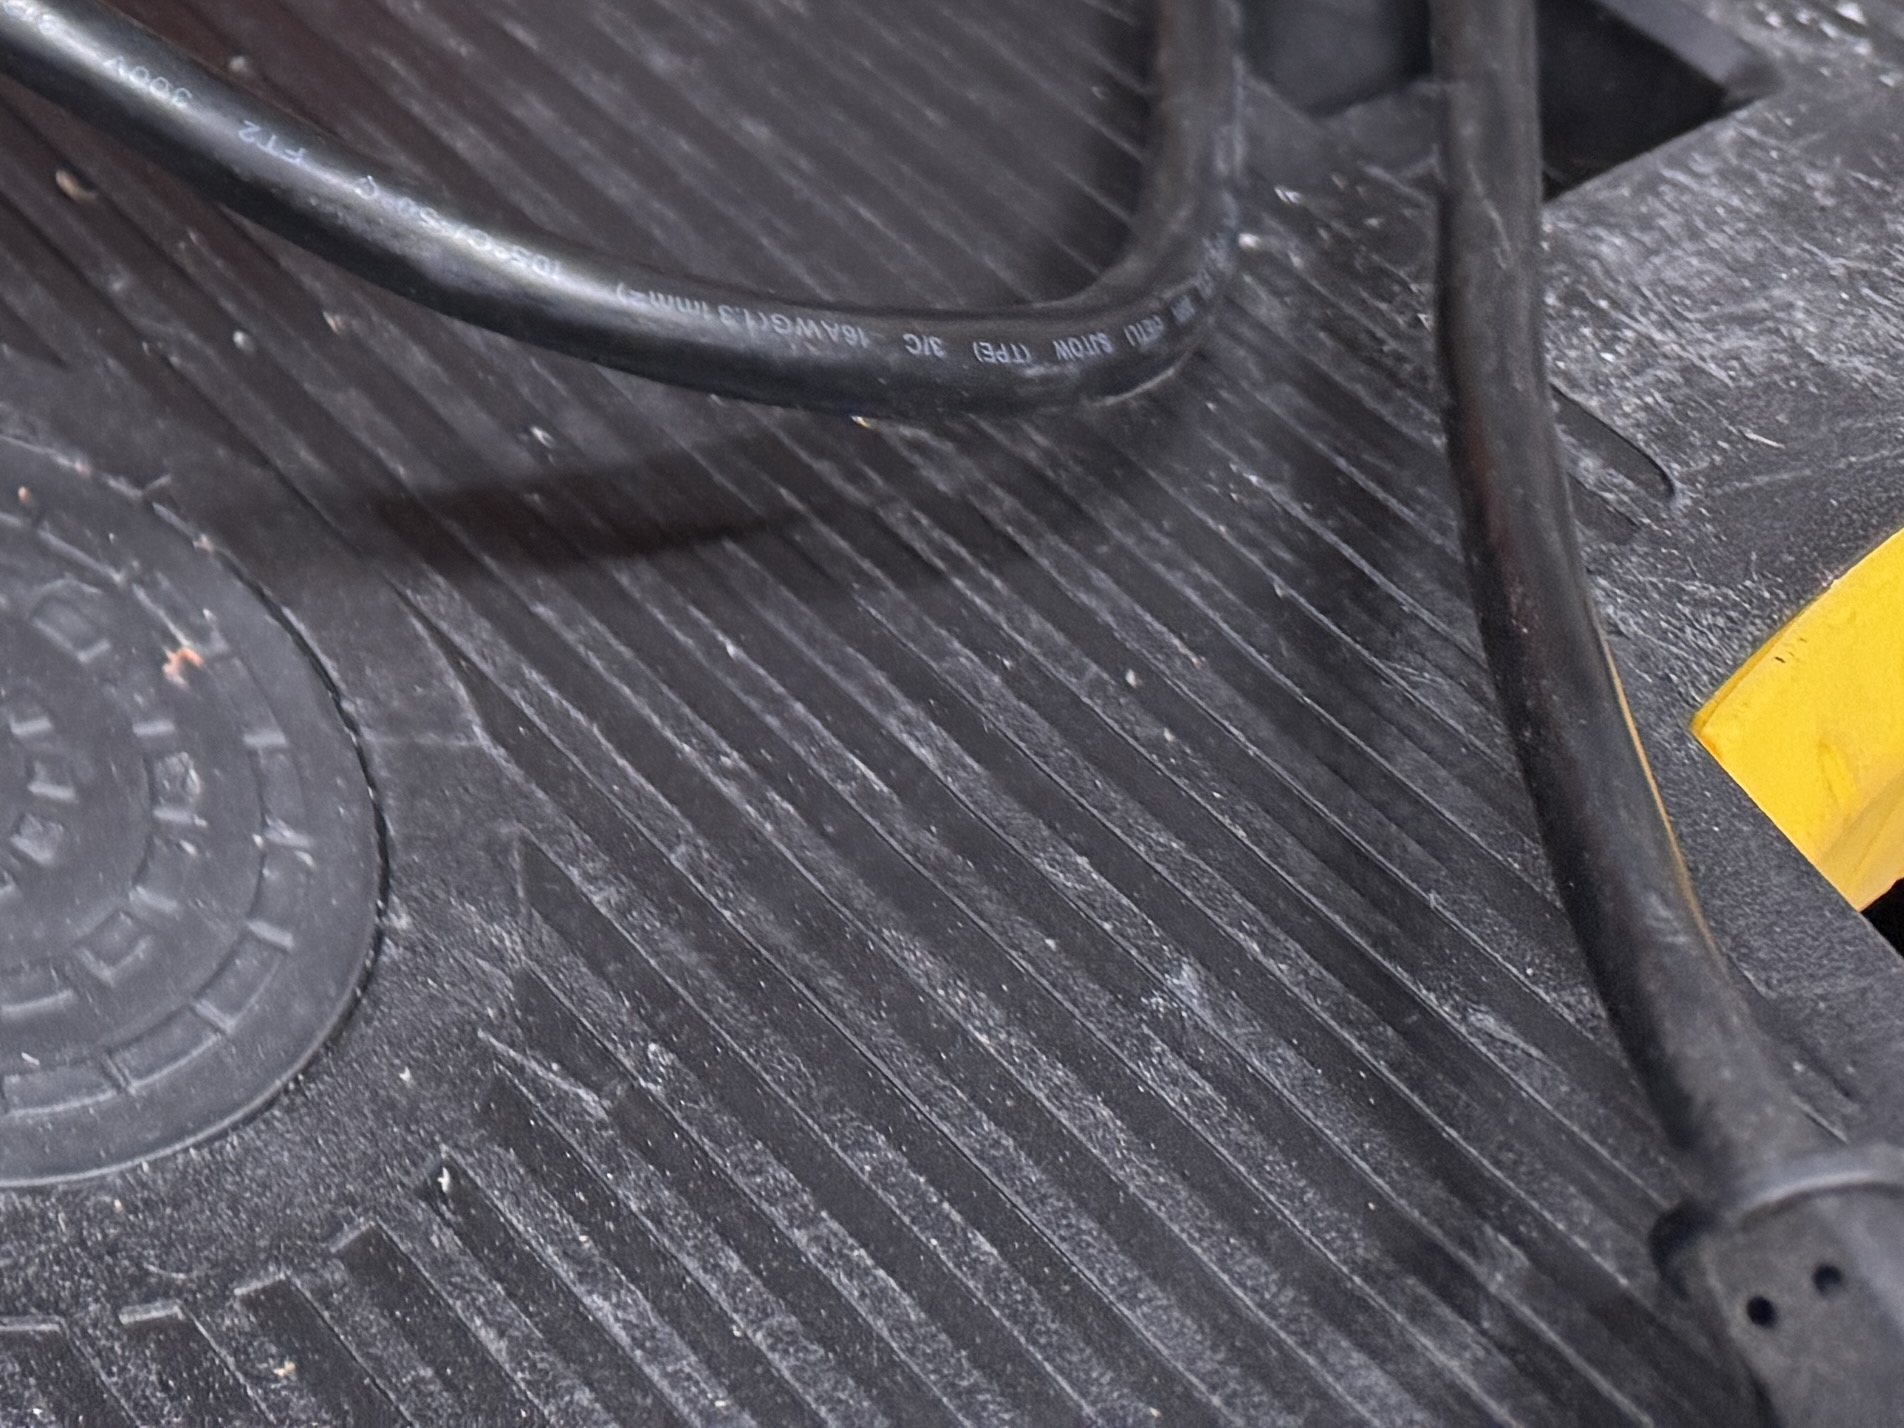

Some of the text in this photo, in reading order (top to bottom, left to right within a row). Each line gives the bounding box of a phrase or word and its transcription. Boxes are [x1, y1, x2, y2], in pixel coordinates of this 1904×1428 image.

[101, 55, 192, 109] 300V
[238, 119, 306, 164] FT2
[972, 341, 1031, 364] (TPE)
[1051, 331, 1114, 362] SJTOW
